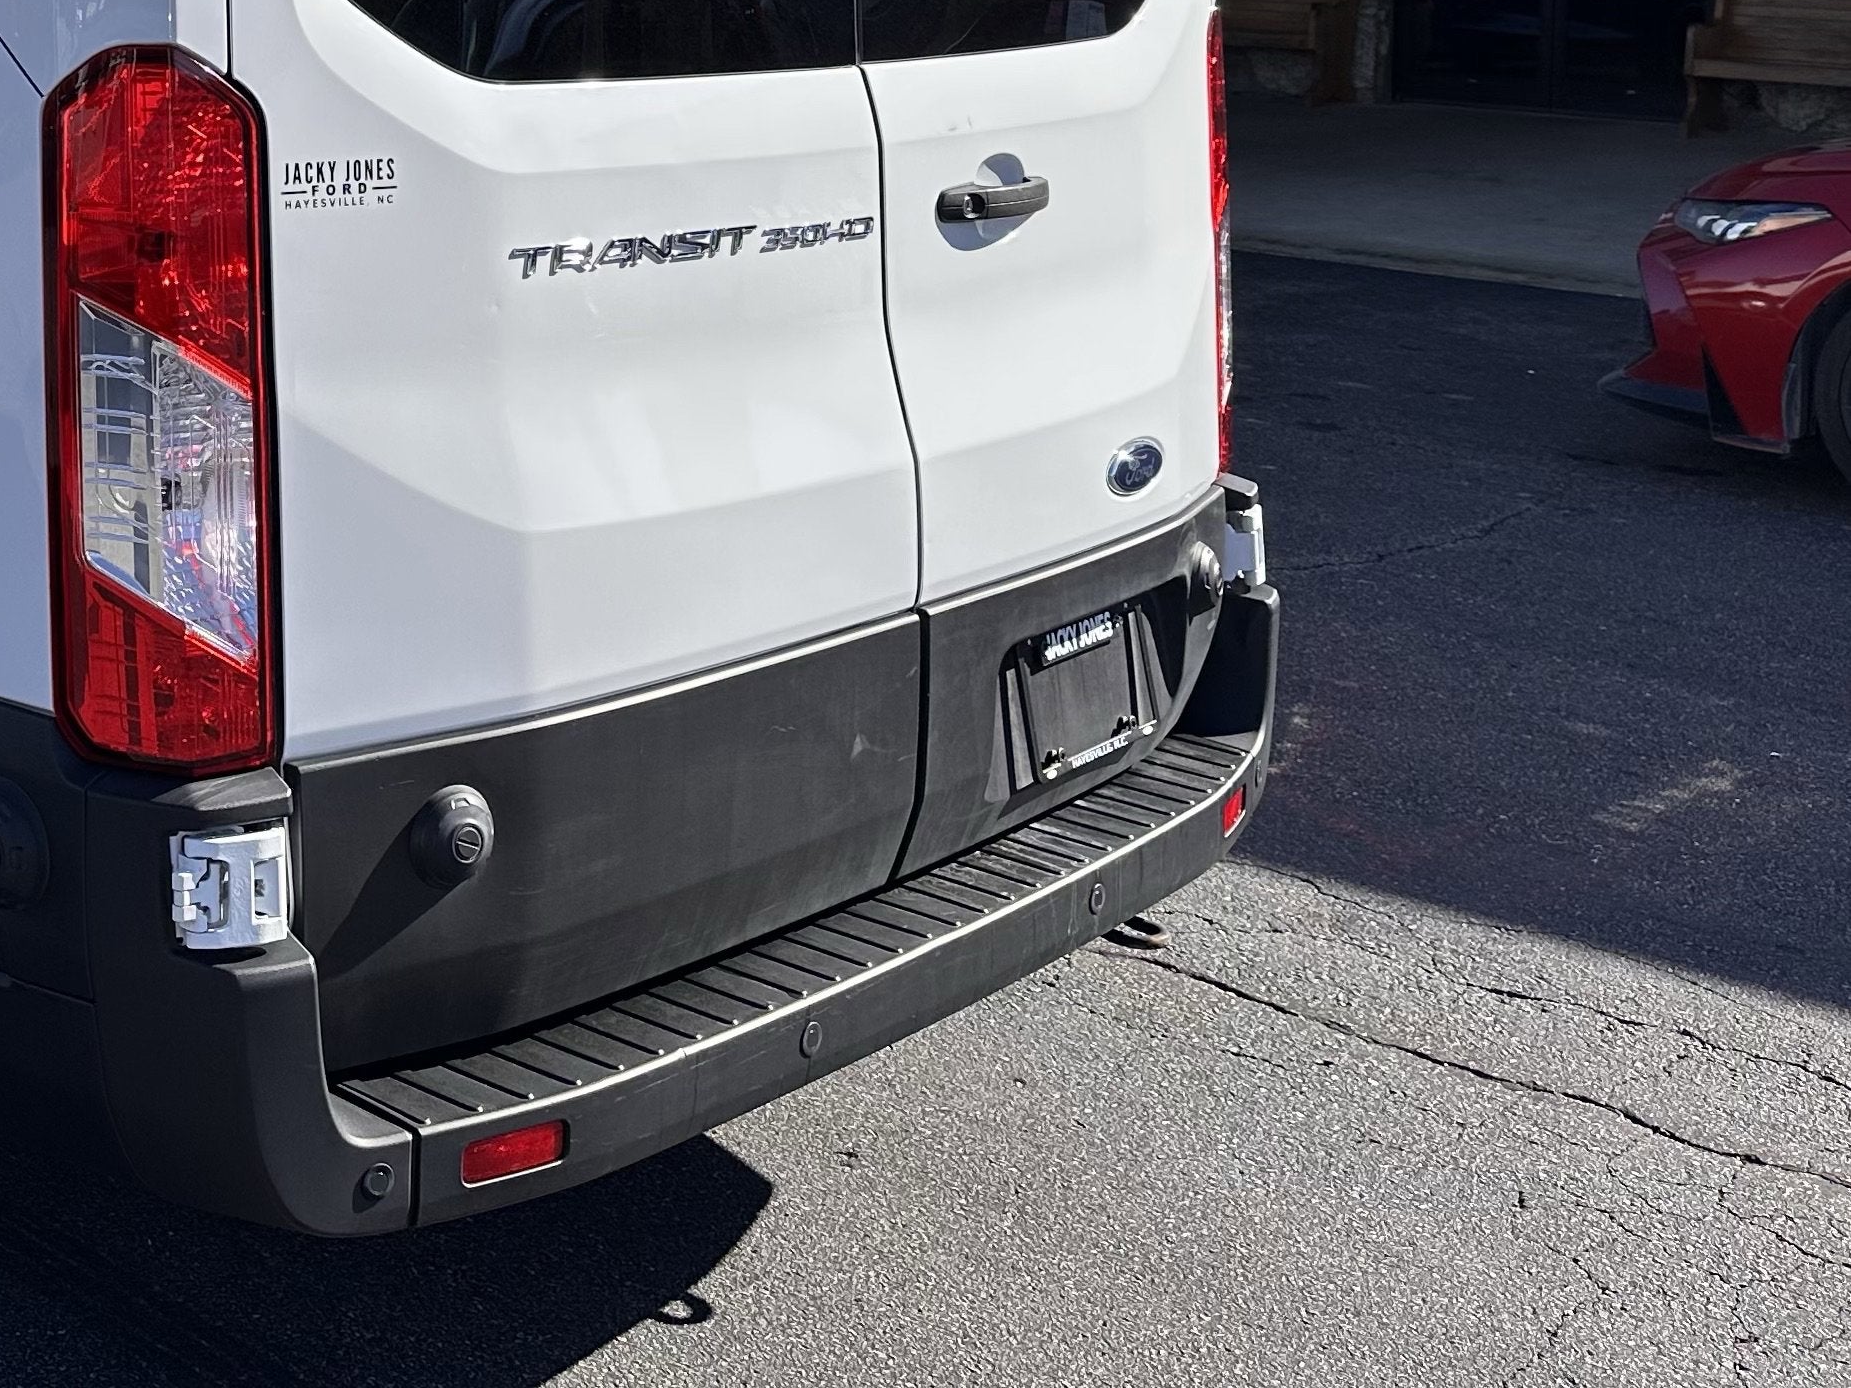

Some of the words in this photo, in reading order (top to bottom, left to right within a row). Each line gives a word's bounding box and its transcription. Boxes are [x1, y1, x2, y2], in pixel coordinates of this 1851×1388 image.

[284, 160, 337, 186] JACKY
[345, 158, 396, 182] JONES
[284, 196, 370, 210] HAYESVILLE,
[377, 194, 394, 204] NC
[311, 182, 367, 197] FORD
[508, 224, 758, 280] TRANSIT
[759, 216, 875, 254] 350HD
[1079, 611, 1114, 648] JONES
